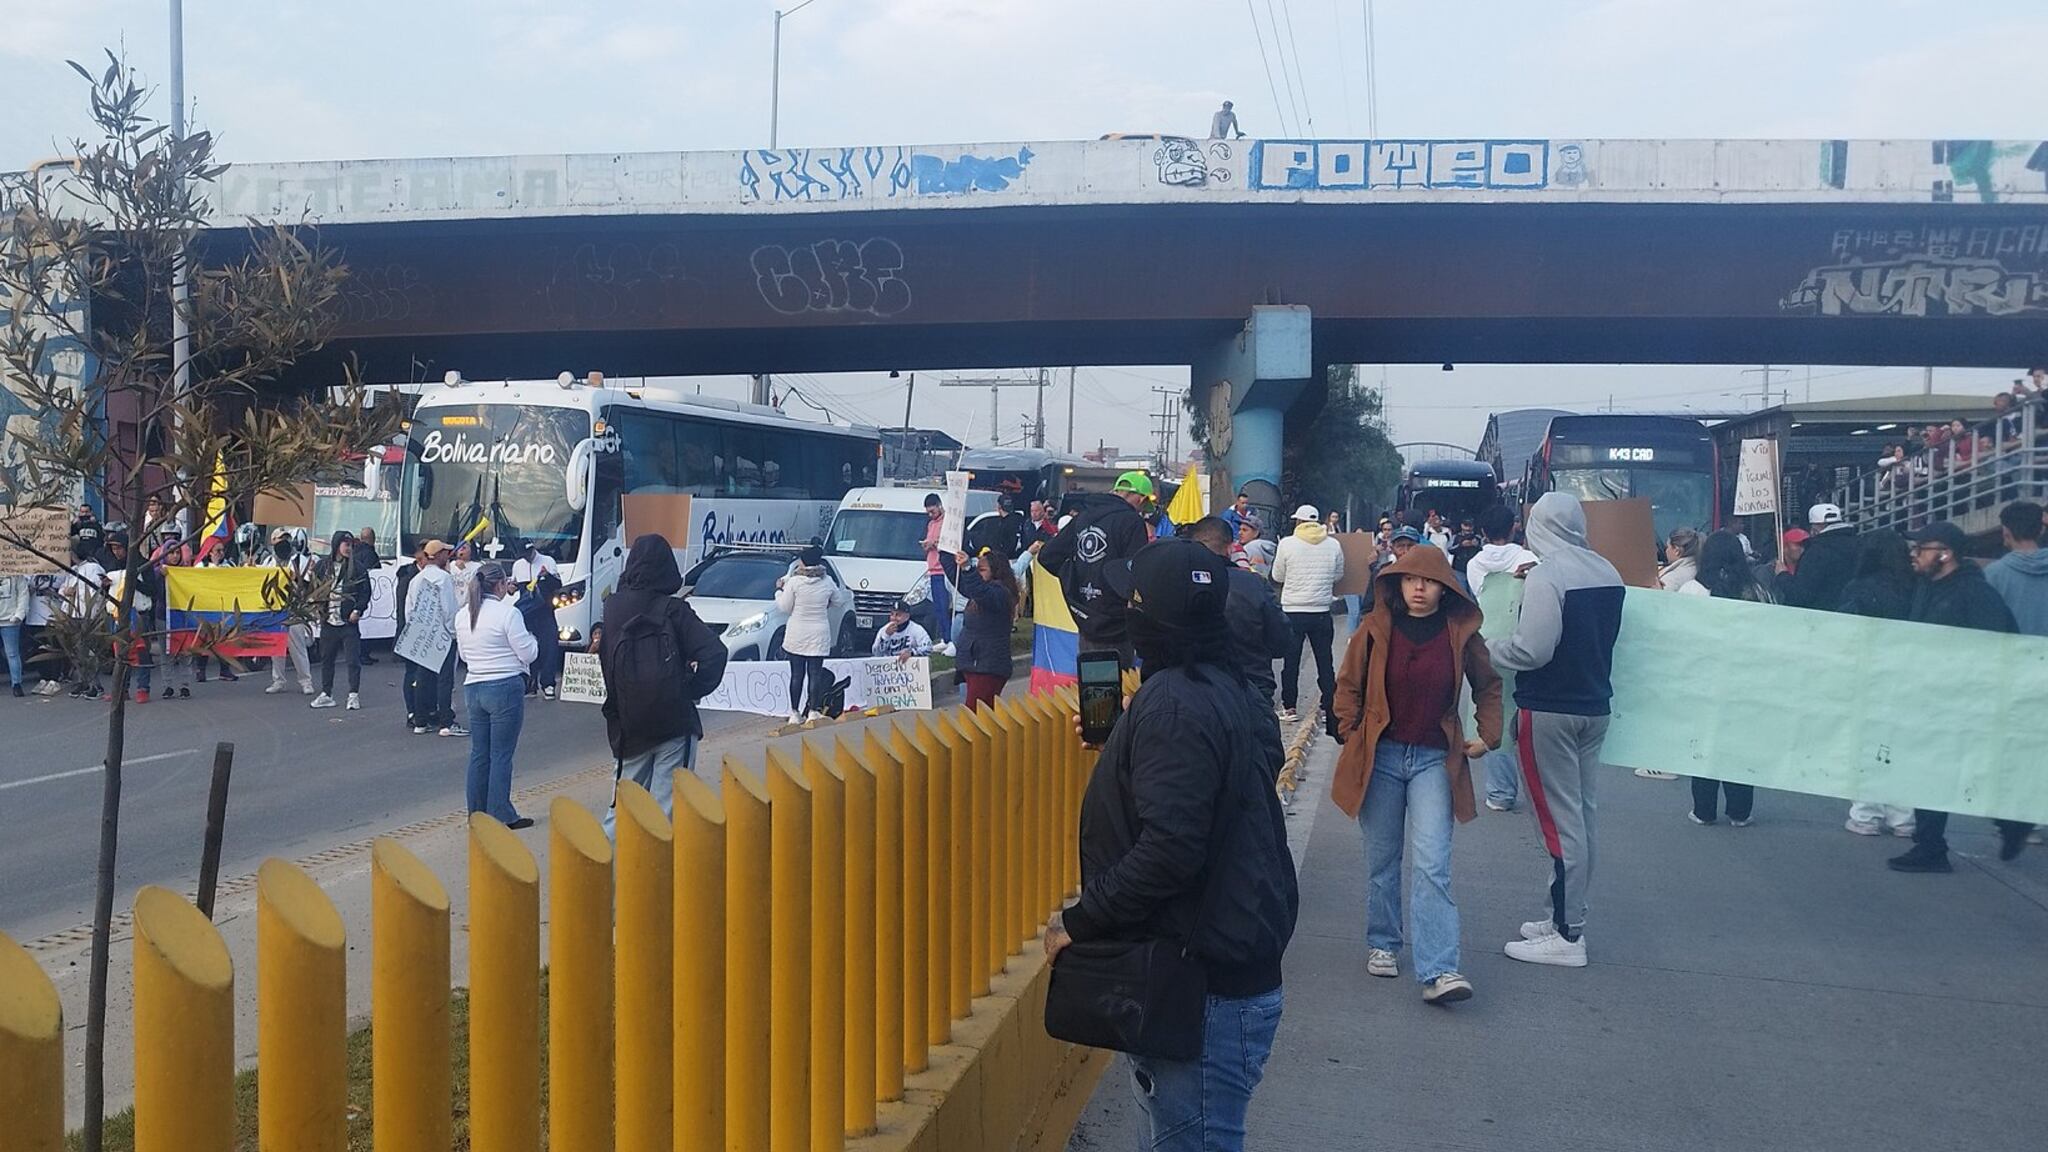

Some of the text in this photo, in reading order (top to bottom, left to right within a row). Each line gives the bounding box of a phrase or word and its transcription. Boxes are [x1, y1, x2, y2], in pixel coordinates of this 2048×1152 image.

[420, 430, 555, 463] Bolivariano
[1609, 448, 1653, 461] K43 CAD
[865, 659, 907, 675] Derecho
[871, 671, 914, 687] TRABAJO
[884, 686, 900, 694] una
[876, 694, 917, 708] DIGNA
